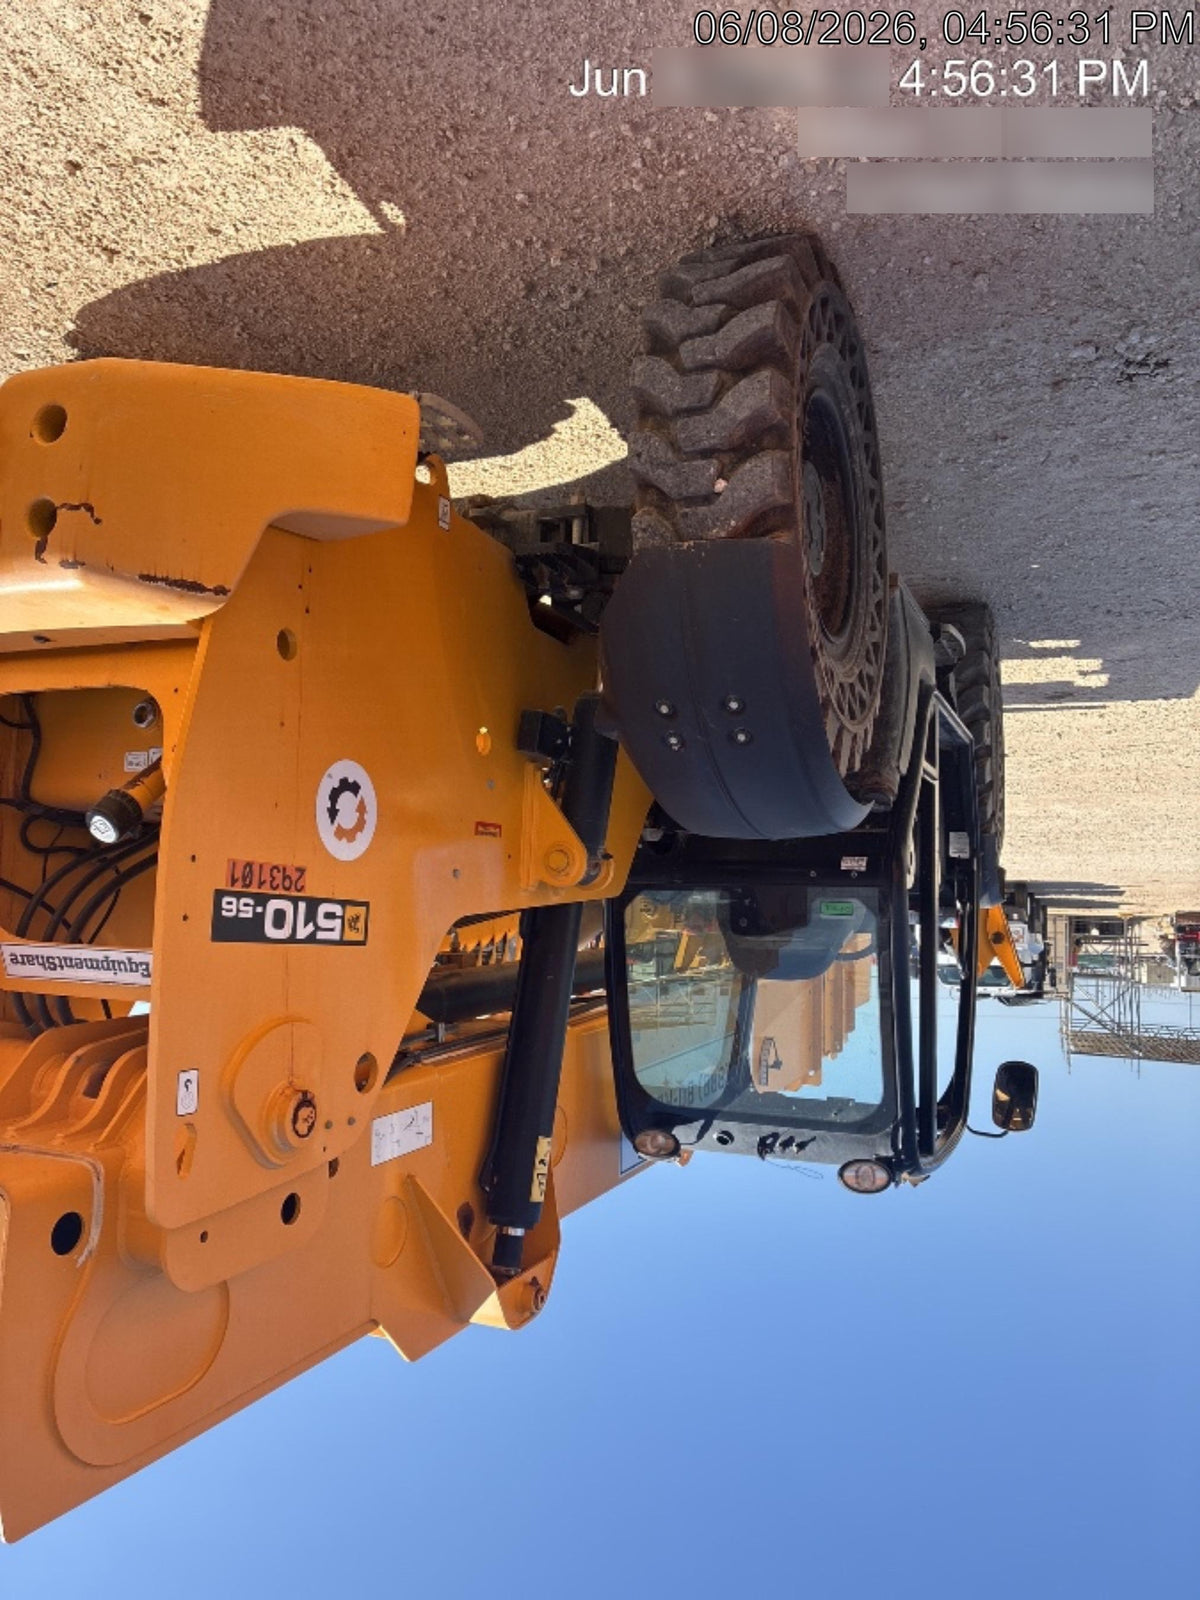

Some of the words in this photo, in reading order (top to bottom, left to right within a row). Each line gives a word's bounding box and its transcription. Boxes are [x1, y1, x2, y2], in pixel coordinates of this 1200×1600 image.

[230, 861, 306, 892] 293101
[221, 896, 343, 940] 510-56
[9, 952, 151, 978] EquipmentShare
